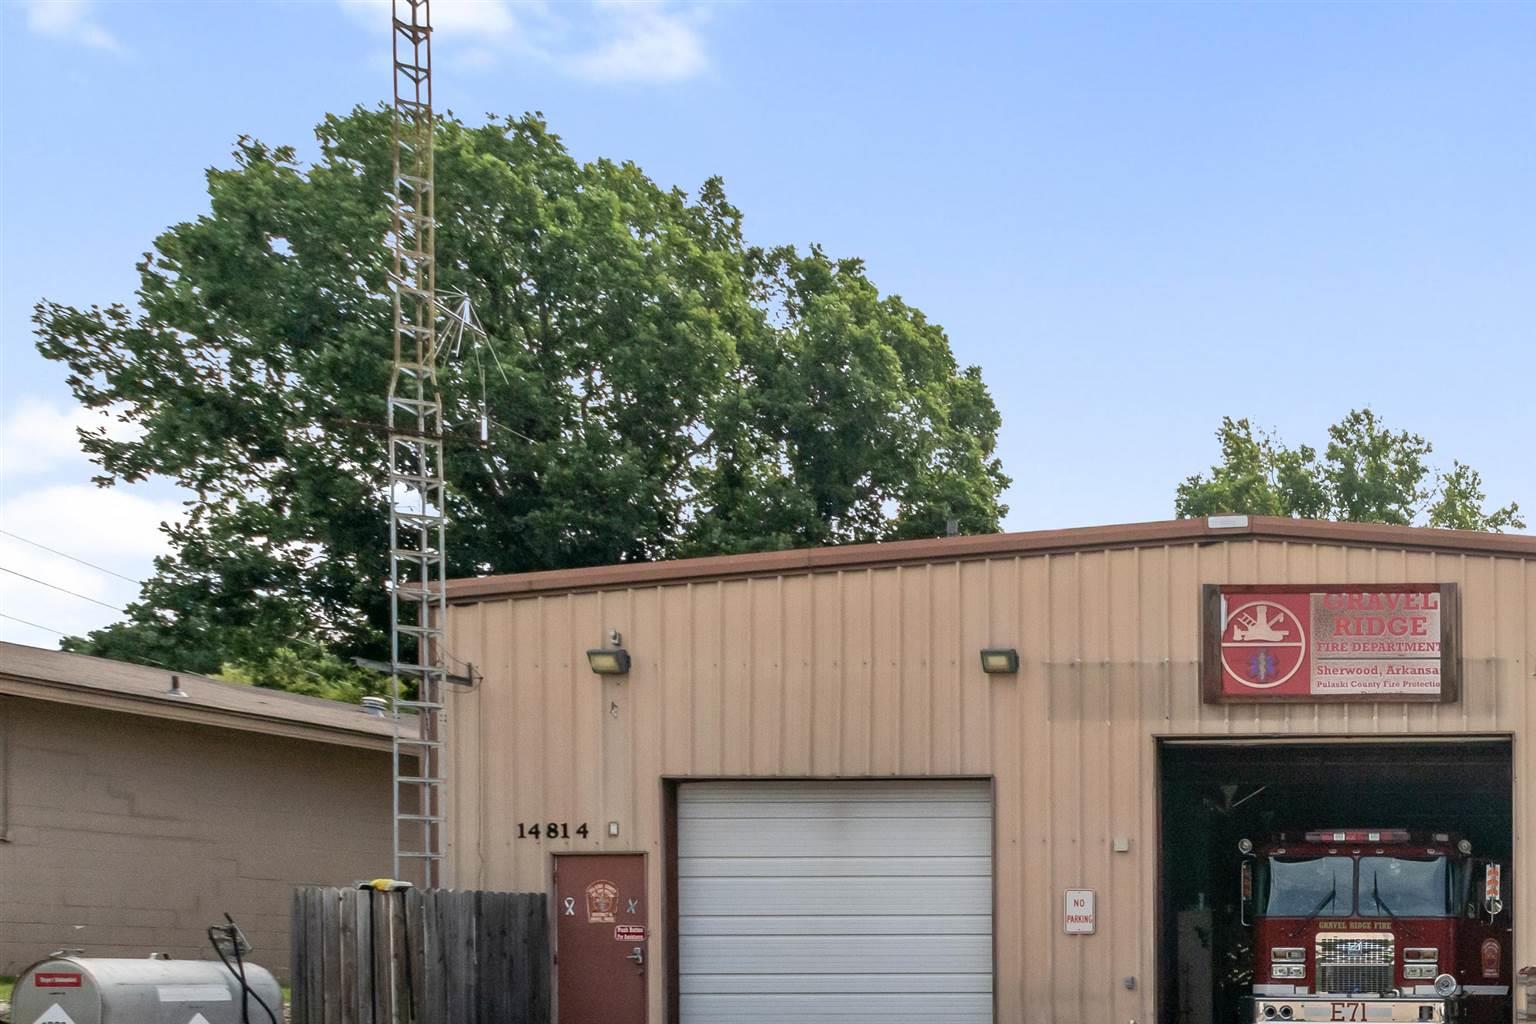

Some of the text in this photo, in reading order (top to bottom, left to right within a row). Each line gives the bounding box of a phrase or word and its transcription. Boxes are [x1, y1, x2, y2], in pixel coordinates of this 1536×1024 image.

[1323, 593, 1438, 610] GRAVEL
[1333, 616, 1427, 636] RIDGE
[1316, 641, 1348, 652] FIRE
[1316, 665, 1383, 677] Sherwood,
[1316, 680, 1349, 688] Pulaski
[1350, 680, 1381, 689] County
[1383, 680, 1400, 688] Fire
[517, 822, 590, 840] 14814
[1073, 899, 1085, 908] NO
[1066, 914, 1094, 923] PARKING
[1318, 921, 1392, 929] GRAVEL RIDGE FIRE
[1330, 1002, 1368, 1022] E71
